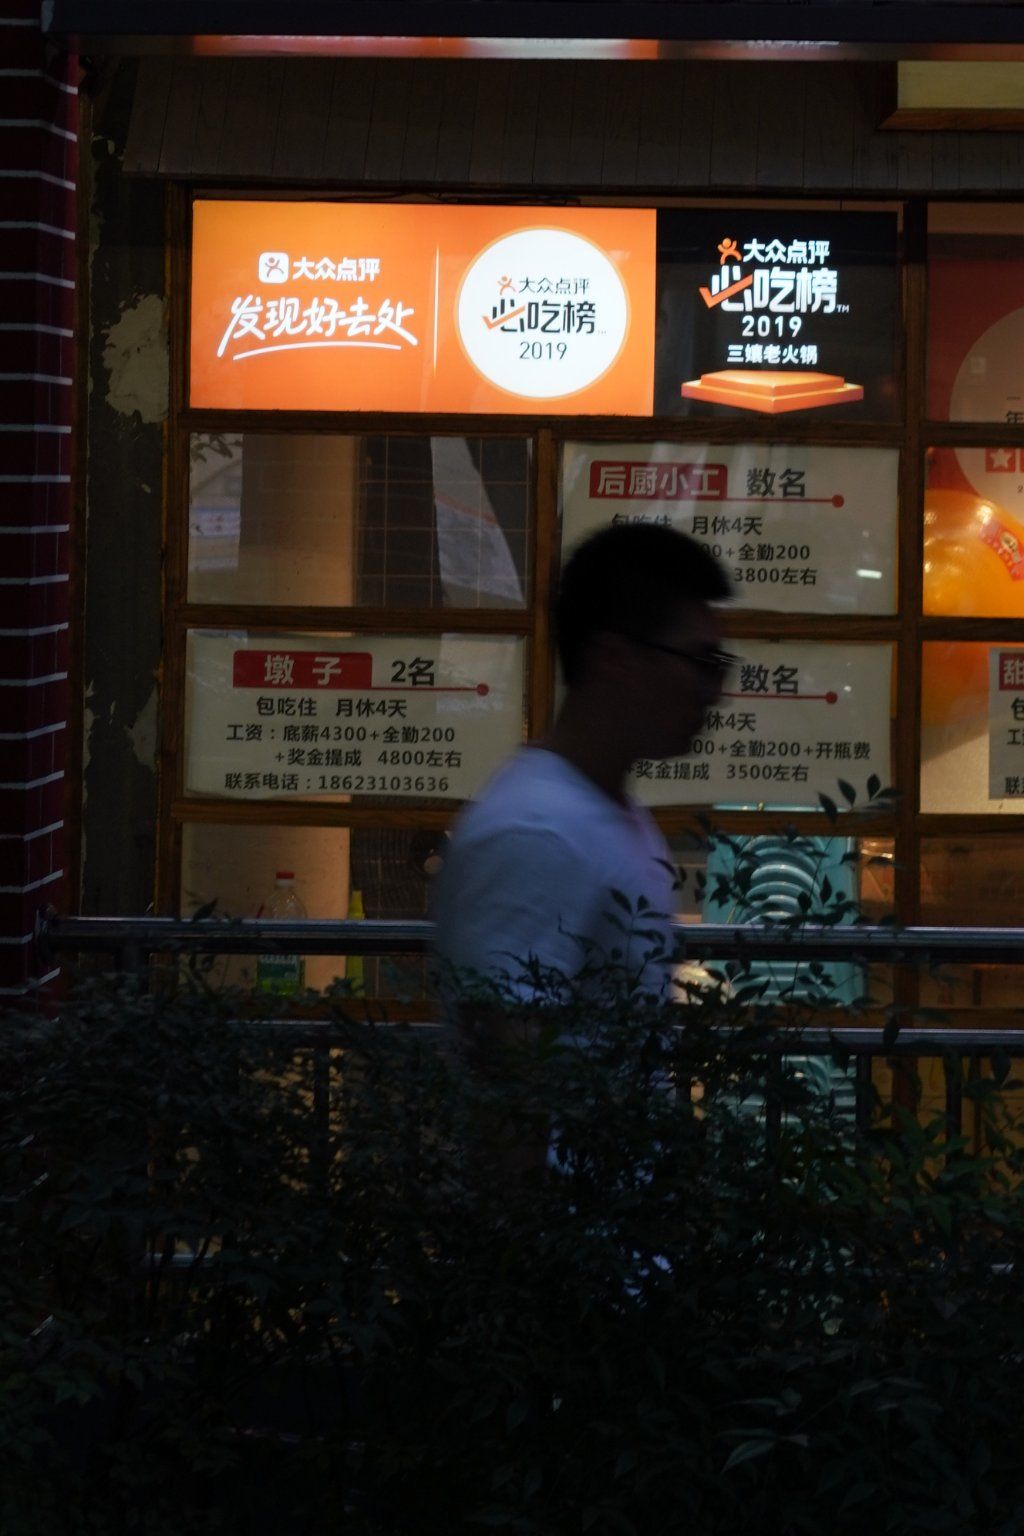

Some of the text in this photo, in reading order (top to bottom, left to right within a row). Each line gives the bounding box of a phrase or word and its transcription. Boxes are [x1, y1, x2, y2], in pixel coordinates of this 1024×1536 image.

[740, 238, 830, 264] 大众点评
[292, 256, 381, 282] 大众点评
[518, 276, 590, 295] 大众点评
[698, 265, 838, 314] 必吃榜
[216, 294, 418, 358] 发现好去处
[482, 298, 596, 334] 必吃榜
[741, 315, 802, 337] 2019
[519, 341, 568, 360] 2019
[596, 466, 806, 498] 后厨小工 数名
[691, 515, 763, 536] 月休4天
[733, 567, 817, 585] 3800左右
[263, 654, 435, 686] 墩子 2名
[740, 665, 799, 694] 数名
[256, 696, 407, 718] 包吃住 月休4天
[378, 750, 462, 767] 4800左右
[687, 739, 871, 760] 00+全勤200+开瓶费
[726, 764, 810, 782] 3500左右
